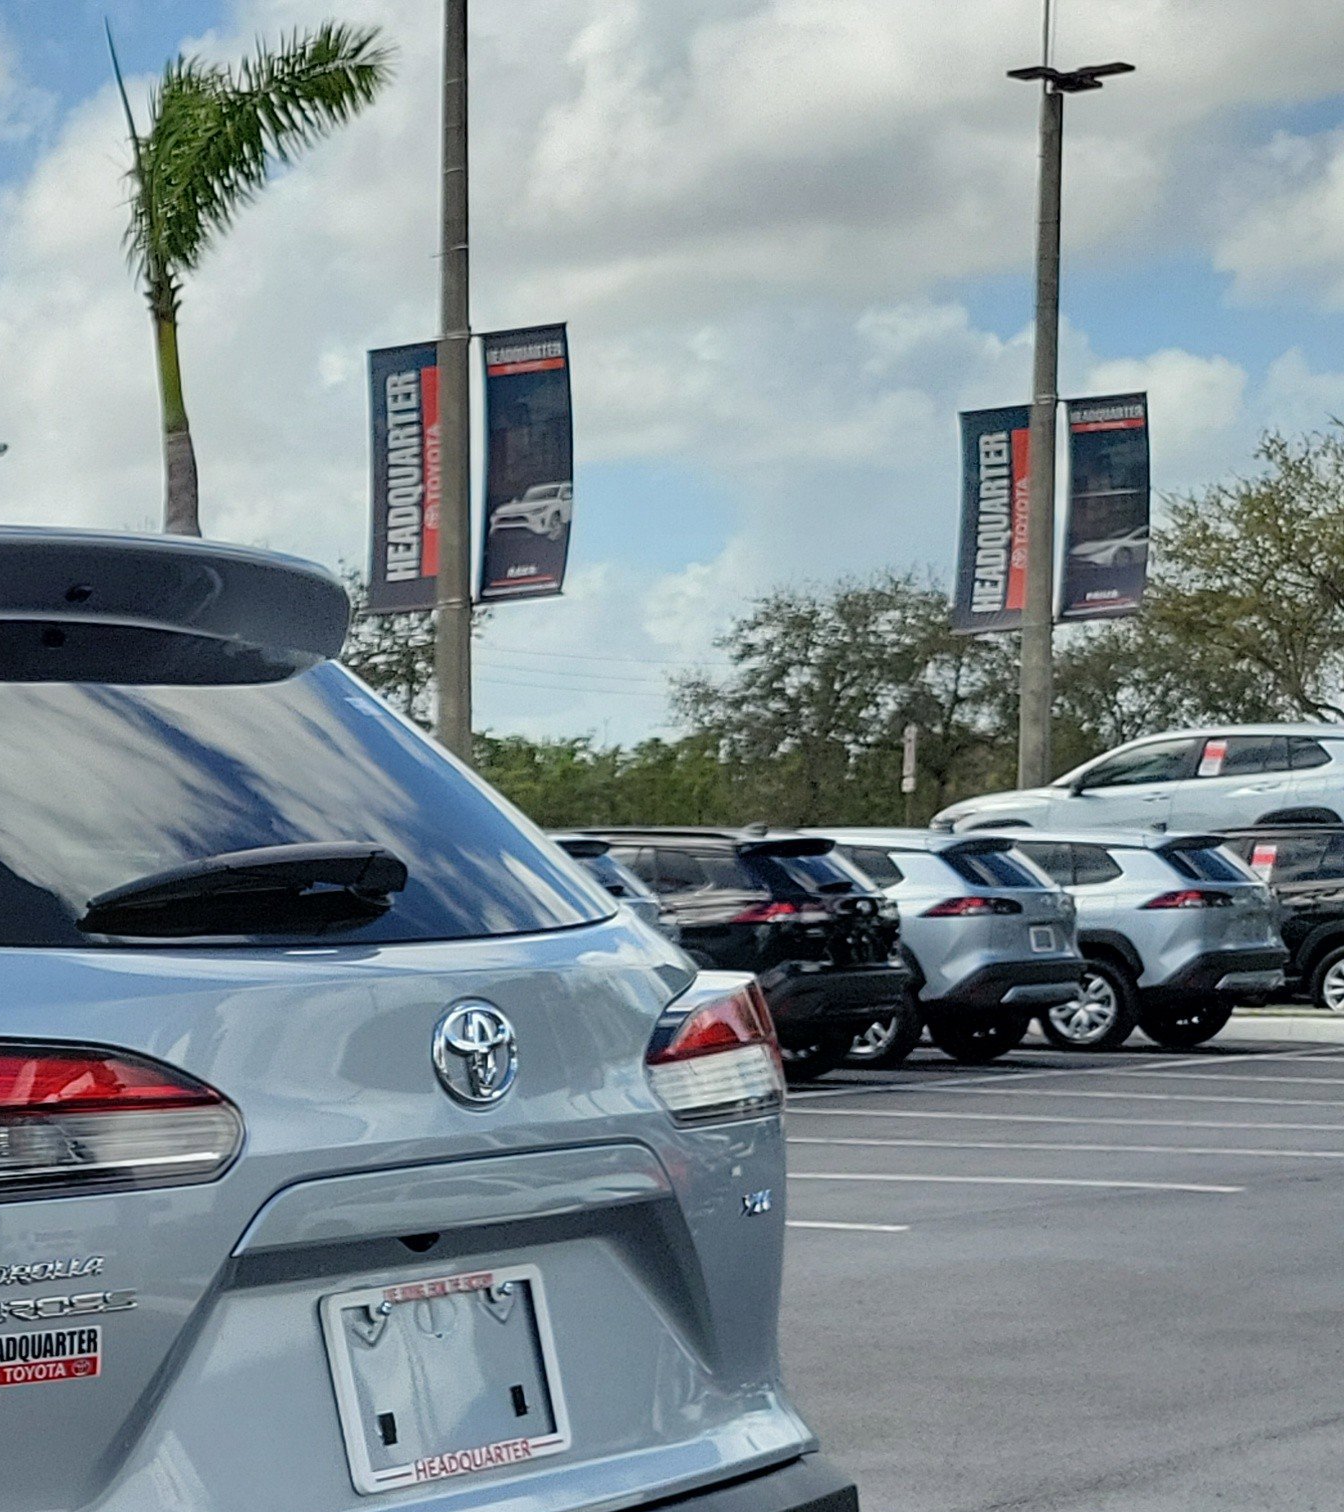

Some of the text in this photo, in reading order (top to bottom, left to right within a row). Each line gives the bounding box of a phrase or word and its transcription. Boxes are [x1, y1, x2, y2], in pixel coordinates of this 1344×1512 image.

[386, 370, 423, 581] HEADQUARTER
[971, 431, 1010, 612] HEADQUARTER
[4, 1364, 66, 1383] TOYOTA
[415, 1440, 531, 1480] HEADQUARTER
